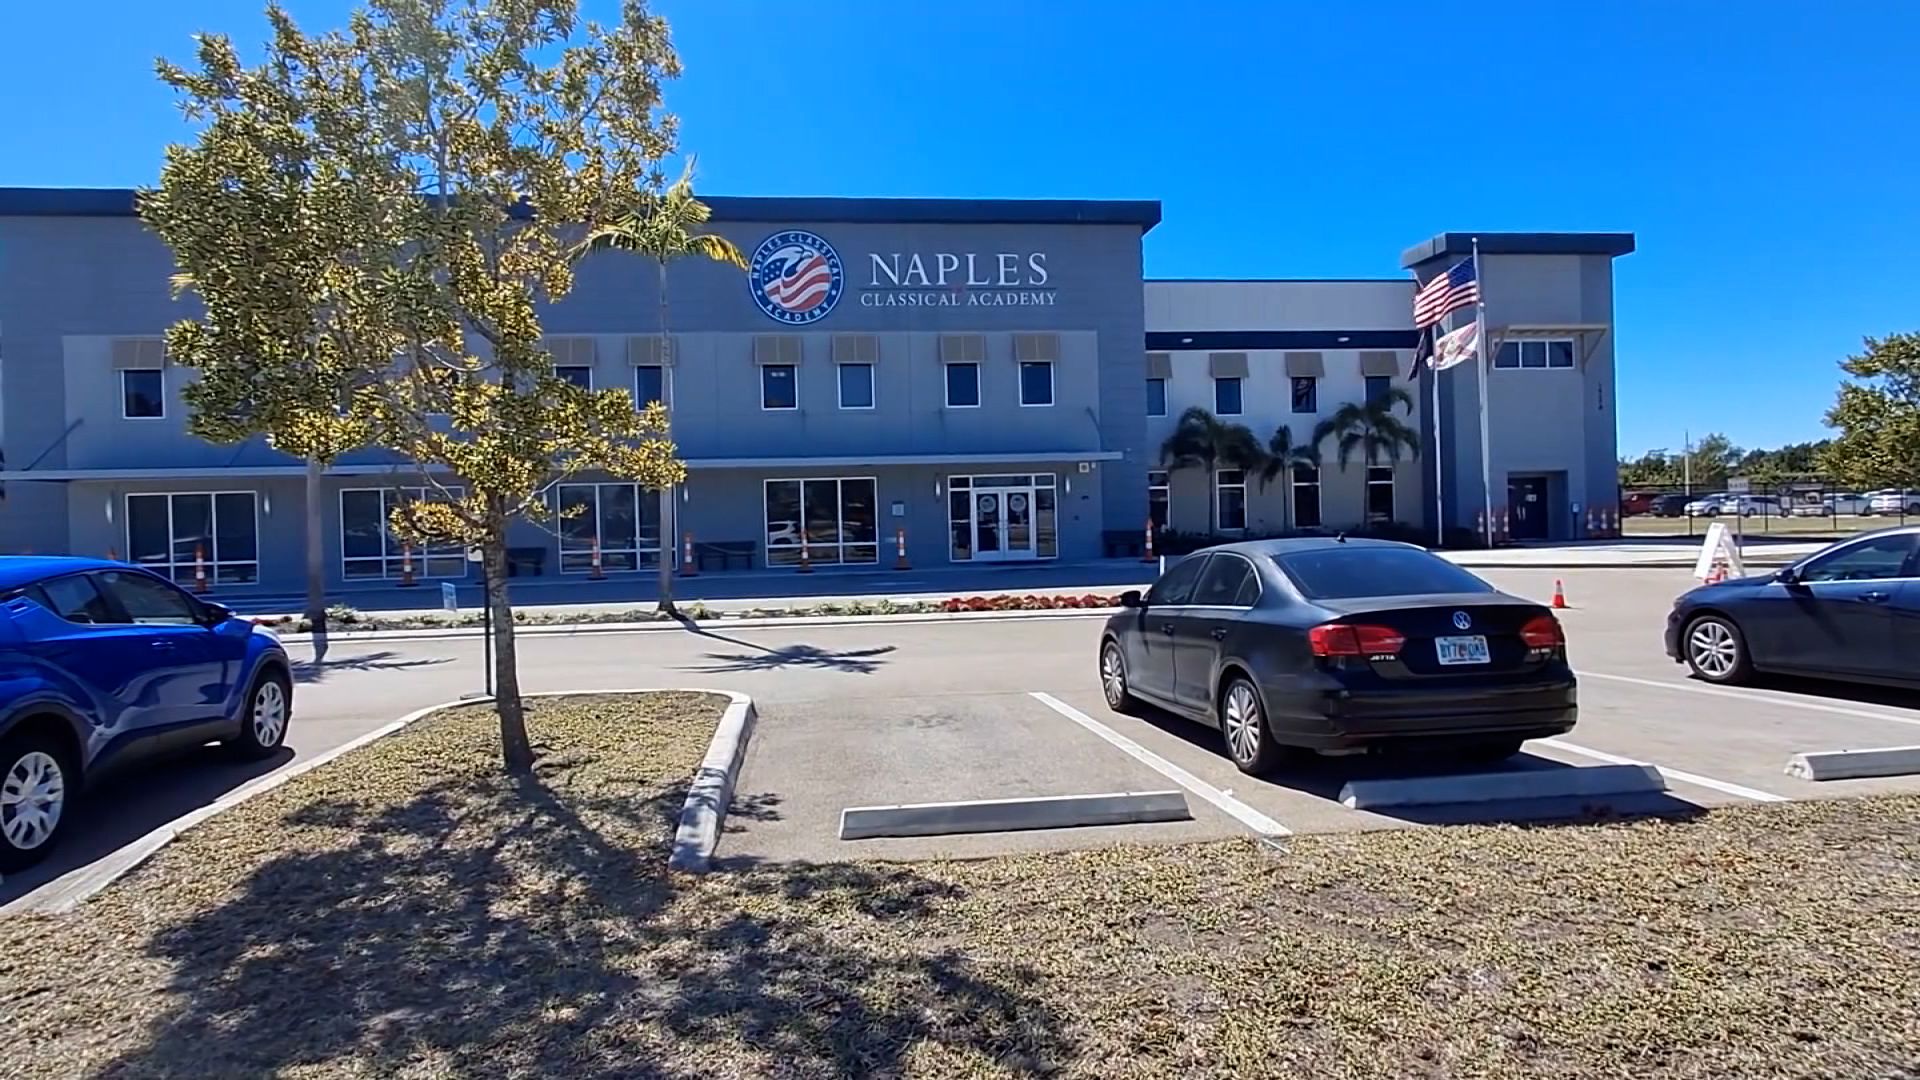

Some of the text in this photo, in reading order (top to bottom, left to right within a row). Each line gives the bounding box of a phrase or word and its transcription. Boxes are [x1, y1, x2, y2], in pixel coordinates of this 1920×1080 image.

[751, 234, 841, 280] NAPLES CLASSICAL
[868, 252, 1049, 286] NAPLES
[766, 301, 829, 321] ACADEMY
[860, 292, 1057, 306] CLASSICAL ACADEMY
